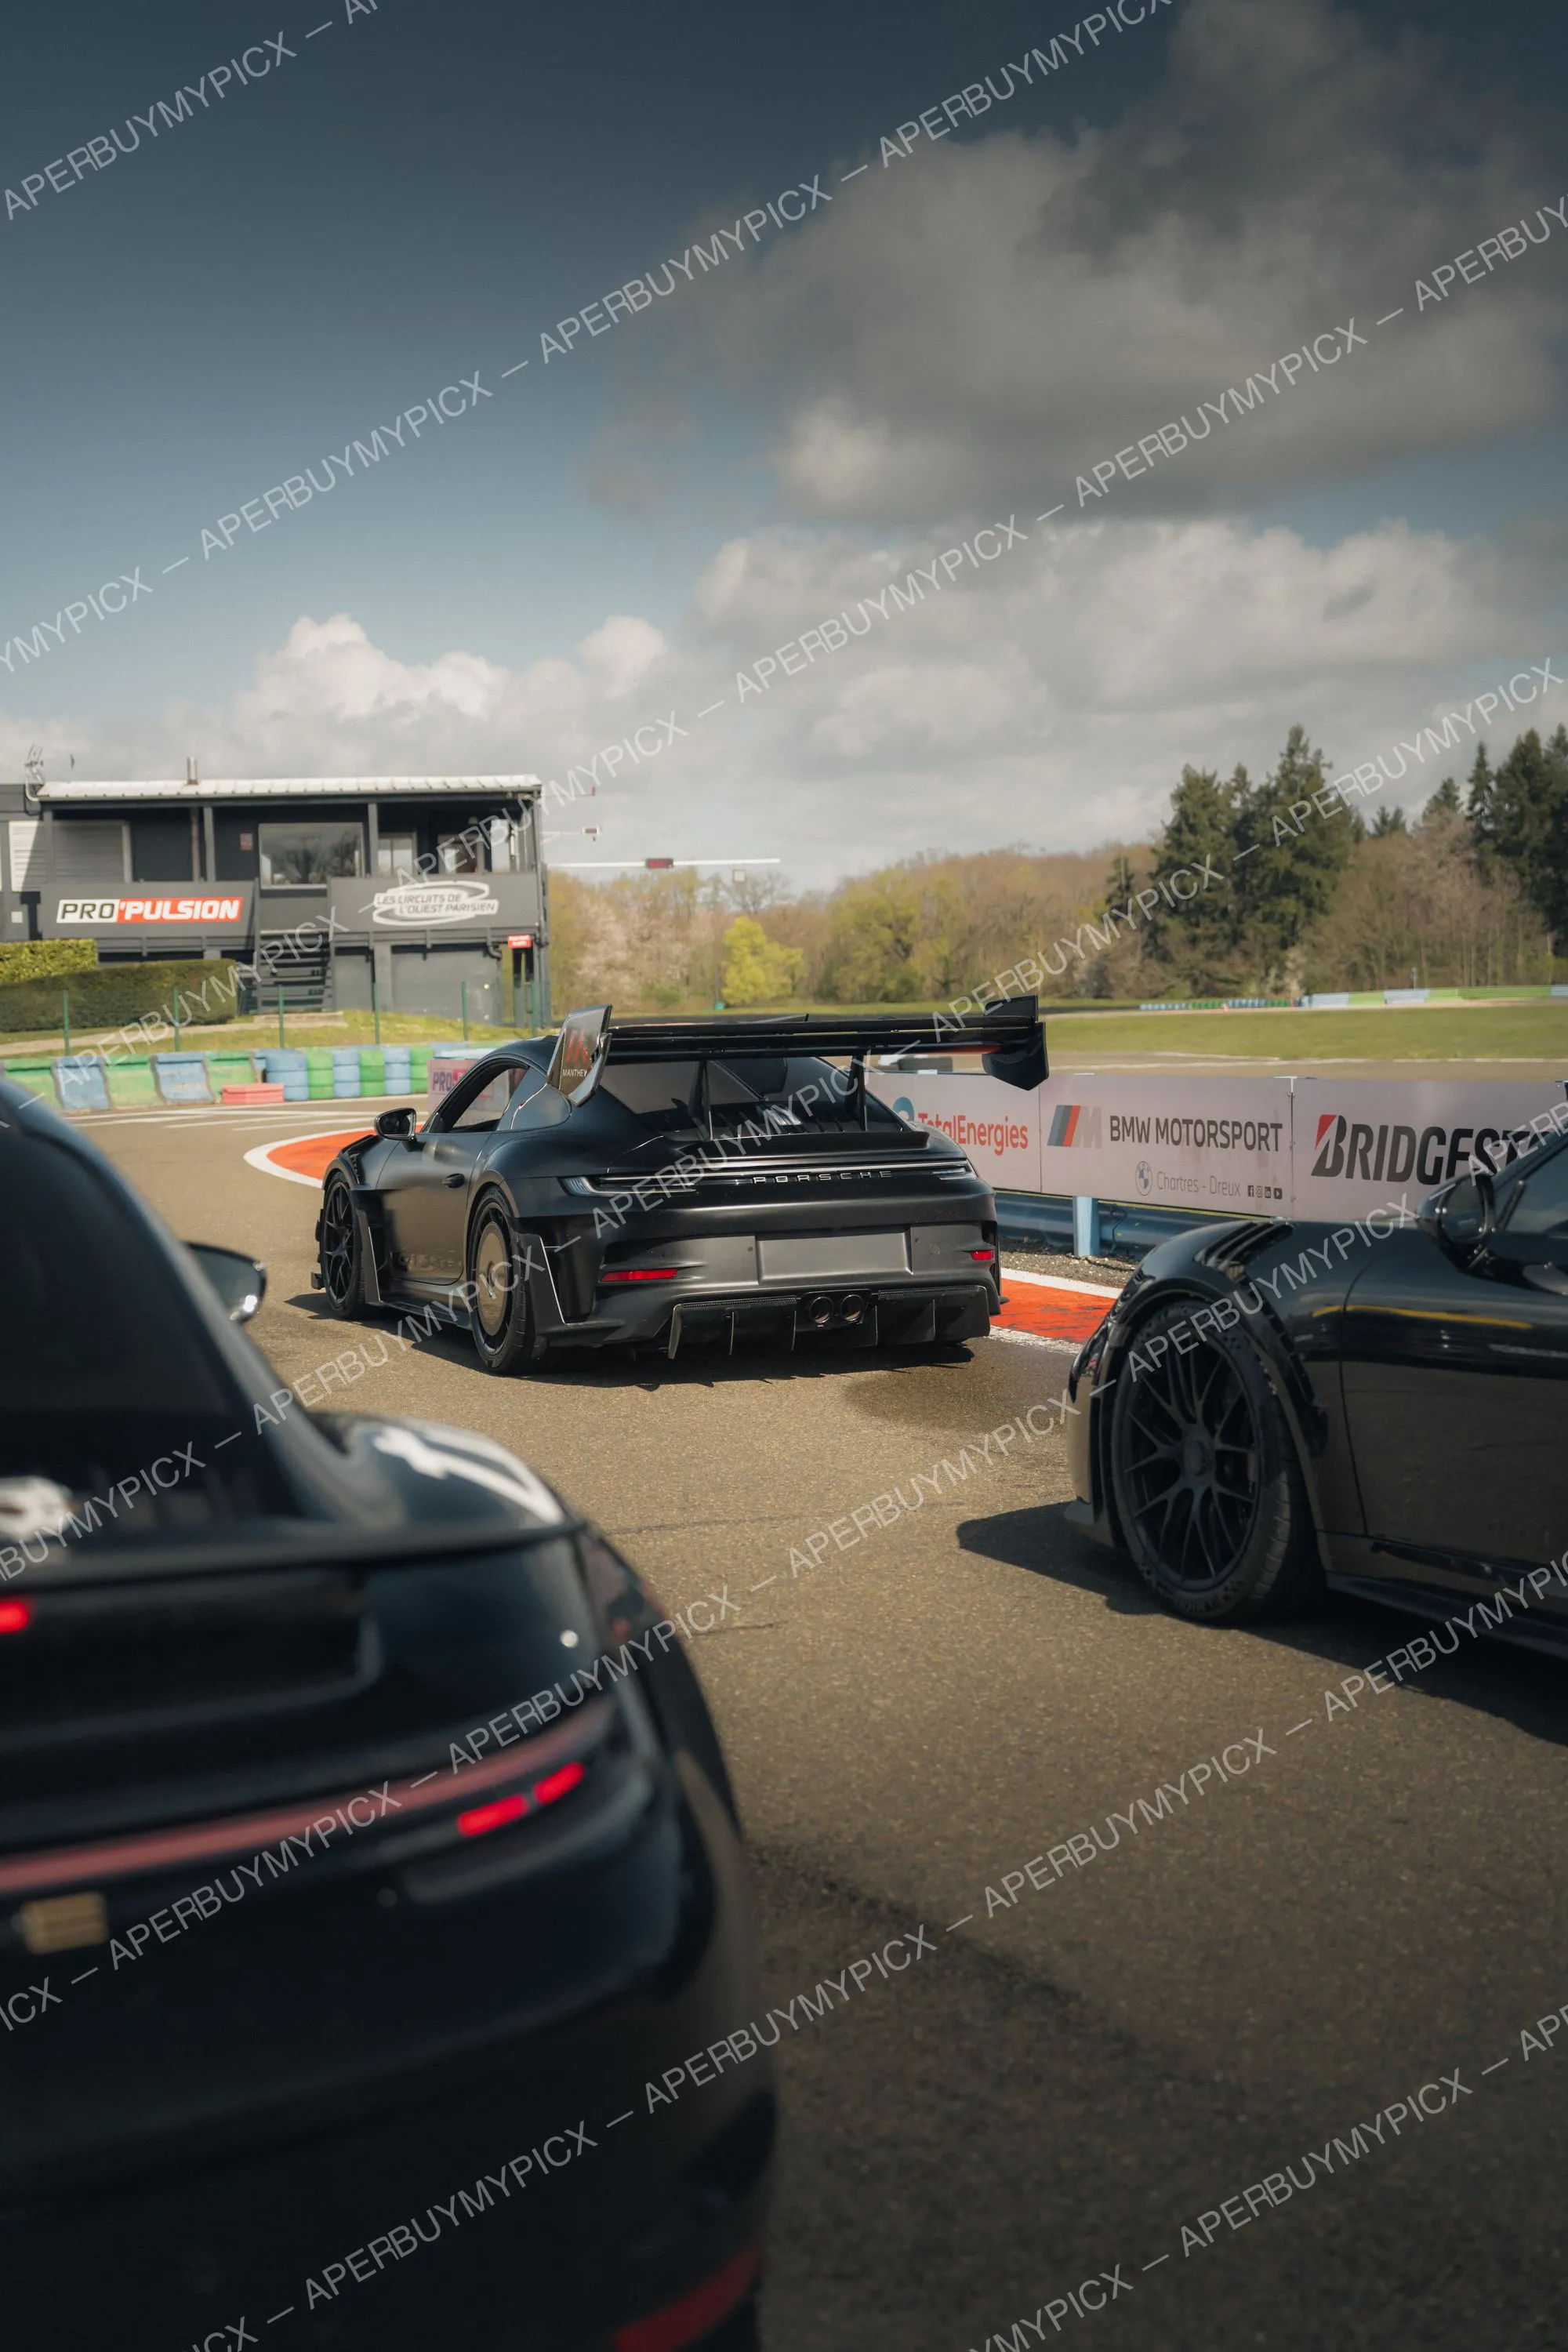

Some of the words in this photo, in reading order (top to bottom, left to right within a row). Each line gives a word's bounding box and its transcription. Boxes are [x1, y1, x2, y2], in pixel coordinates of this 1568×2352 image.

[445, 902, 495, 913] PARISIEN
[917, 1112, 1029, 1156] TtalEnergies
[1109, 1115, 1151, 1144] BMW
[1155, 1117, 1283, 1152] MOTORSPORT
[753, 1171, 892, 1185] PORSCHE
[1156, 1171, 1200, 1193] Chartres
[1209, 1175, 1241, 1197] Dreux
